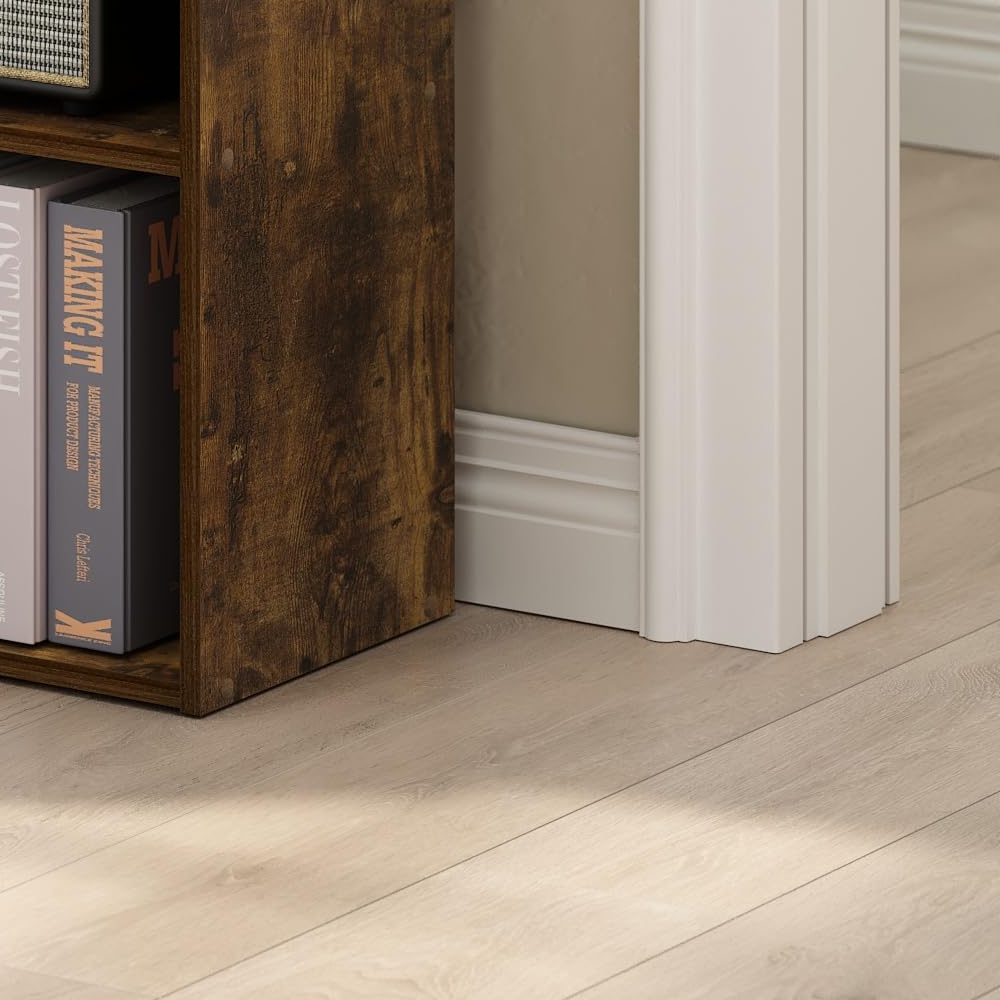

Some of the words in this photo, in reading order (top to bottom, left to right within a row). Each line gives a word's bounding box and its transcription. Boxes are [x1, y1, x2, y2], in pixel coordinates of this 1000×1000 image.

[63, 224, 104, 338] MAKING
[64, 340, 104, 375] IT
[66, 382, 79, 399] FOR
[66, 400, 79, 439] PRODUCT
[88, 386, 101, 458] MANUFACTURING
[66, 438, 79, 471] DESIGN
[88, 456, 101, 510] TECHNIQUES
[76, 532, 91, 554] Chris
[76, 555, 91, 583] Lefteri
[55, 609, 112, 642] K
